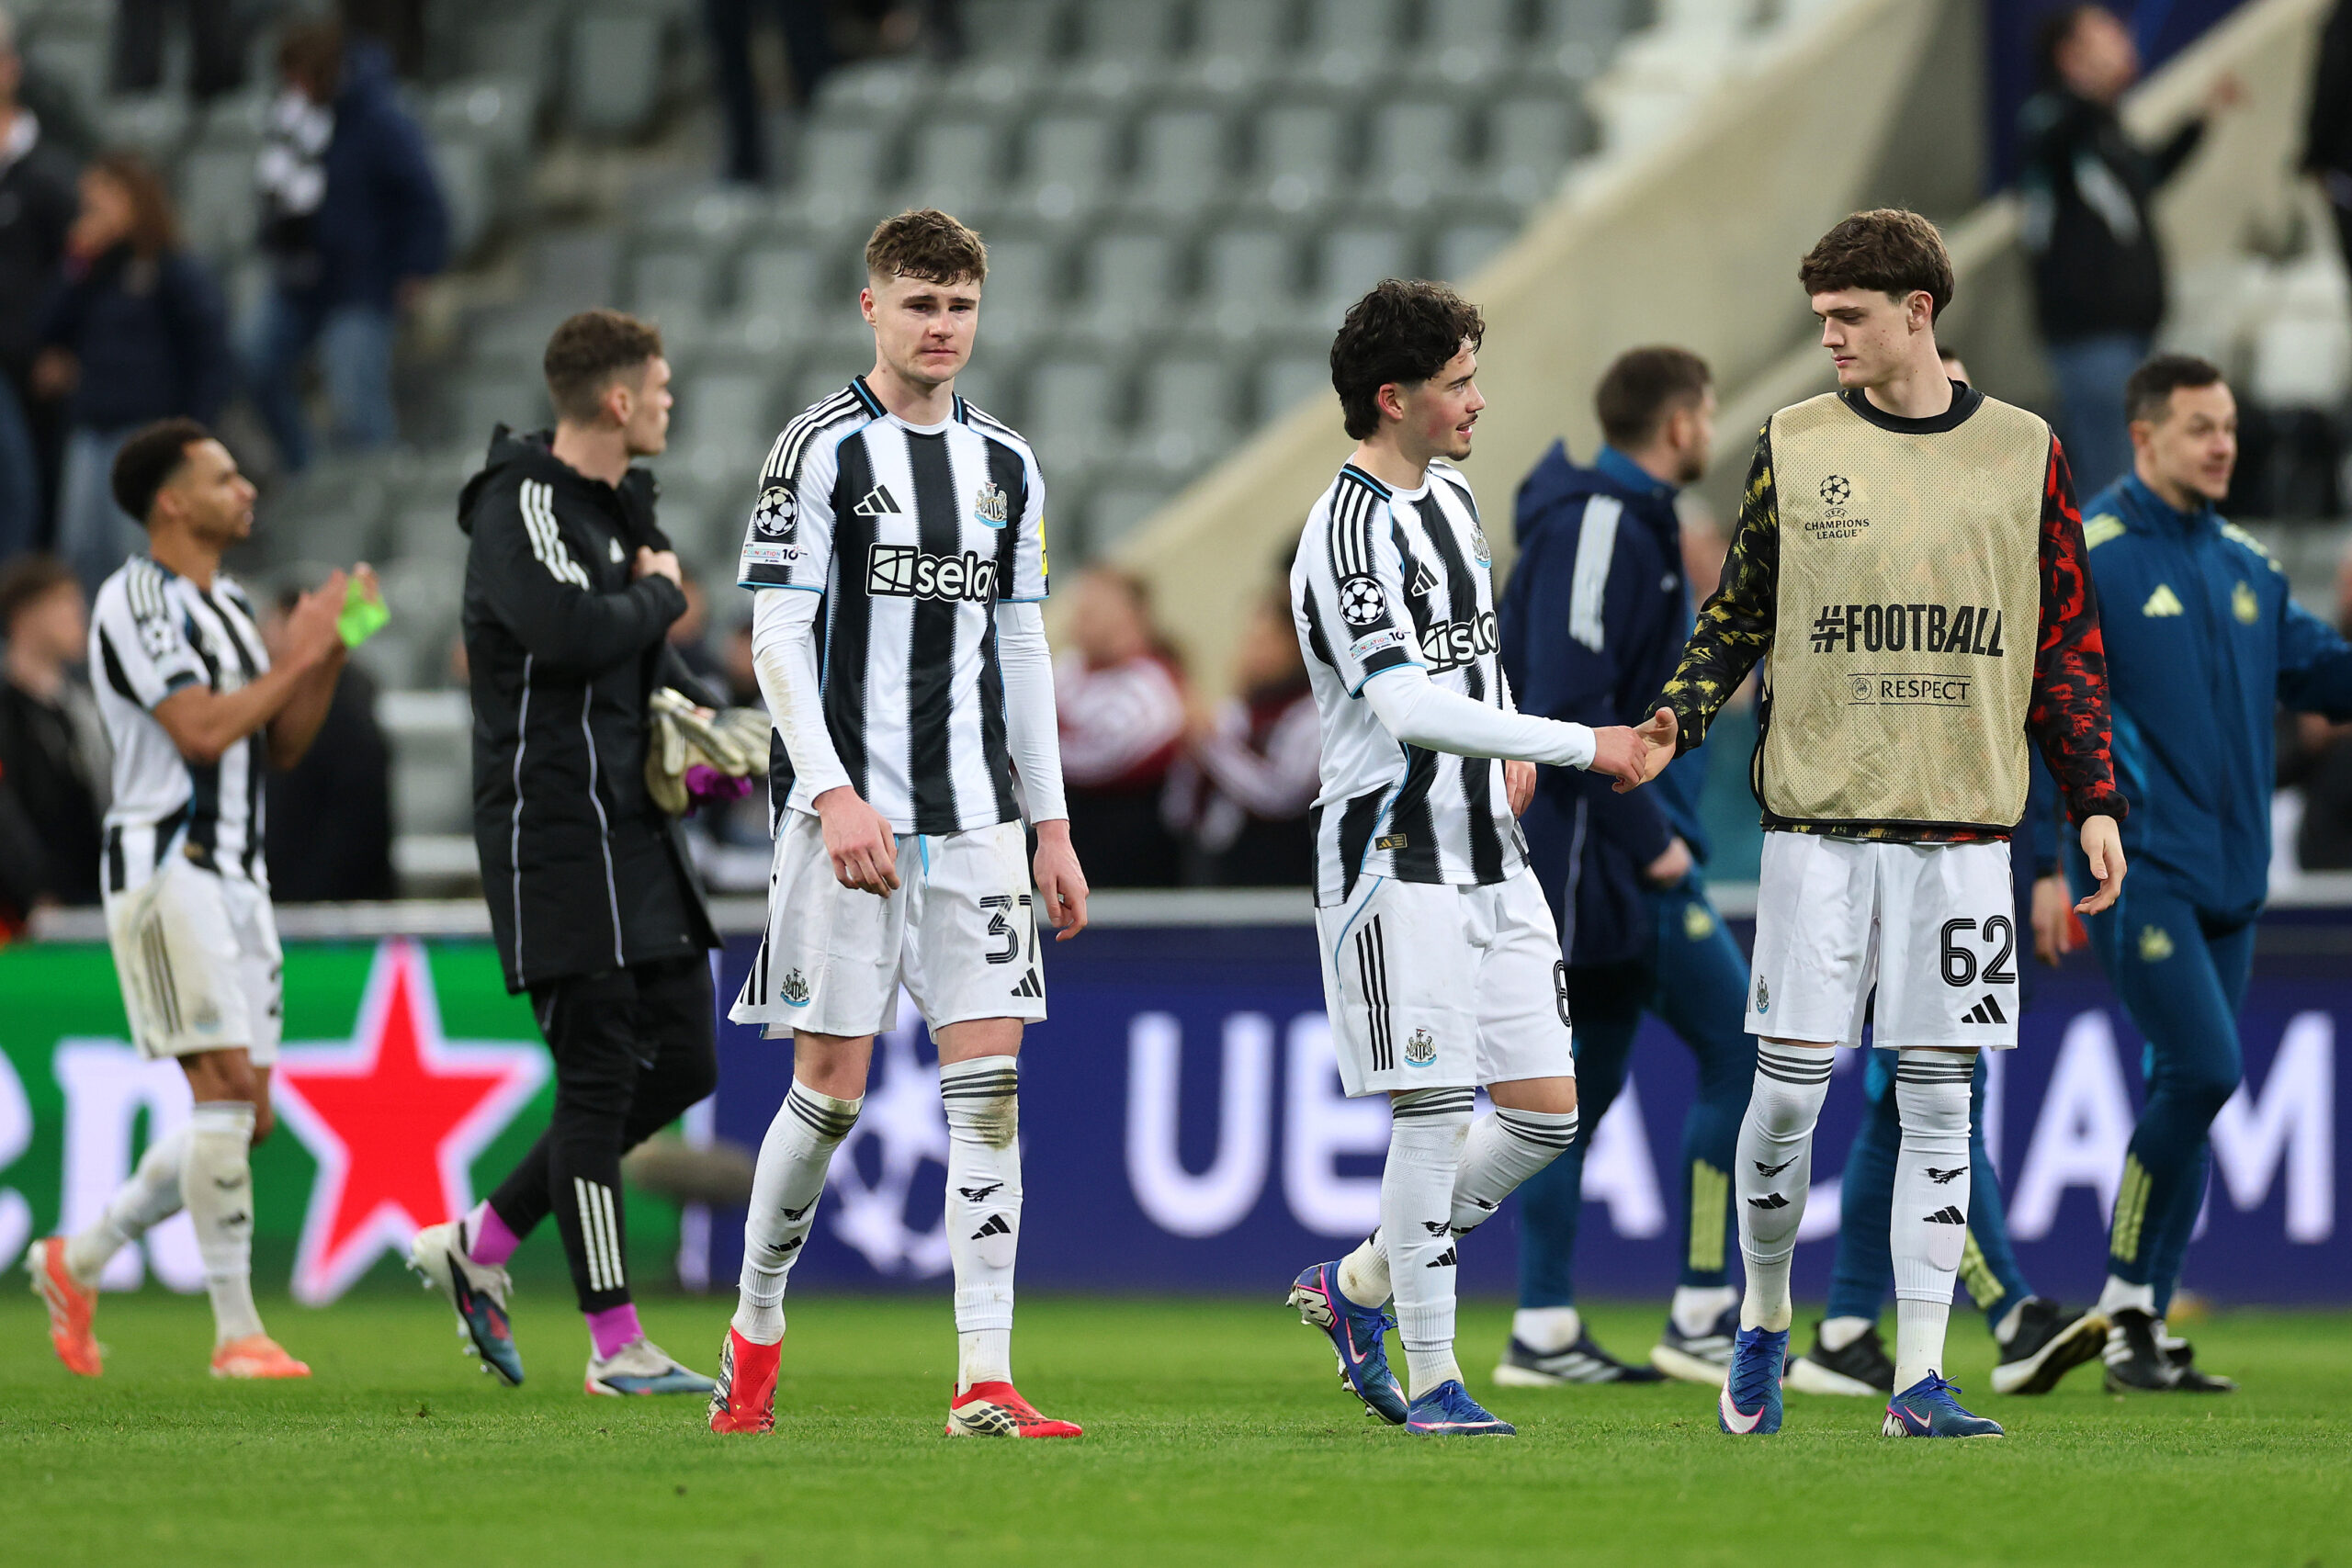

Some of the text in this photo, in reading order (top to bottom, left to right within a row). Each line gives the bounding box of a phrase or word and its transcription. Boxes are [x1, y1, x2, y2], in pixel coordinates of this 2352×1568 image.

[1804, 517, 1870, 531] CHAMPIONS
[1816, 528, 1858, 540] LEAGUE
[915, 555, 994, 598] sela
[1810, 604, 2004, 657] #FOOTBALL
[1881, 680, 1971, 700] RESPECT
[1940, 915, 2016, 987] 62
[1125, 1010, 1665, 1241] UEA
